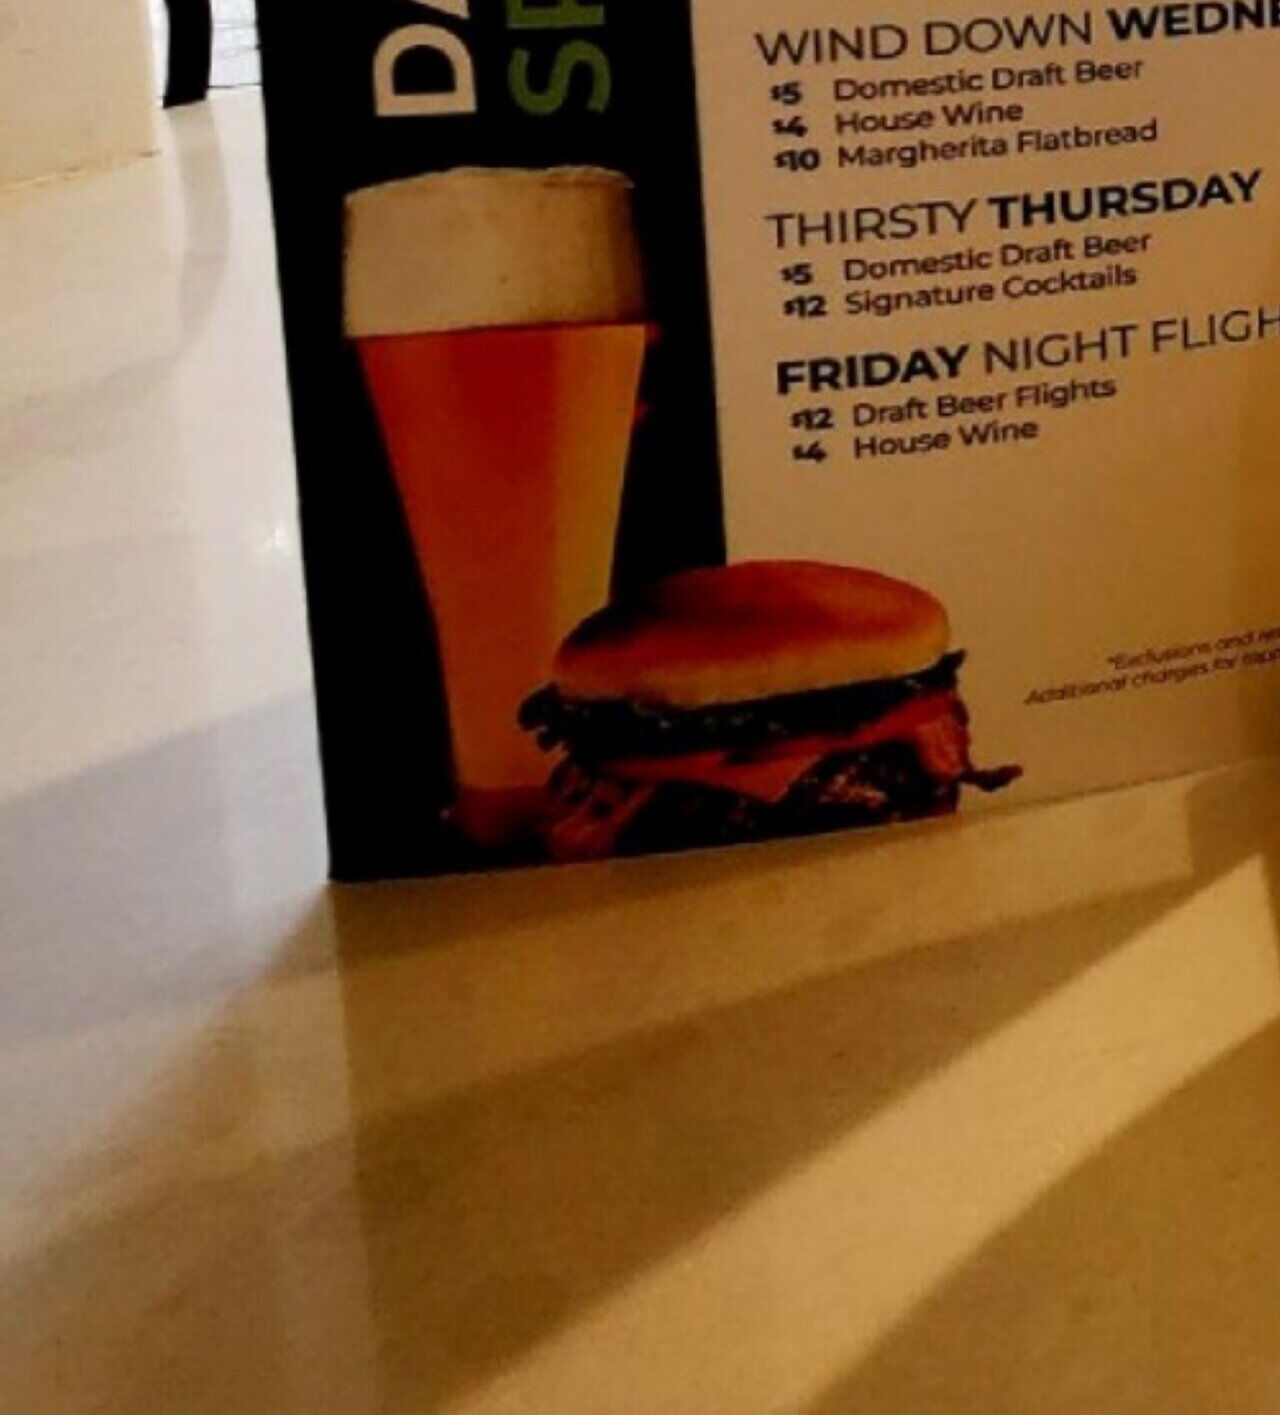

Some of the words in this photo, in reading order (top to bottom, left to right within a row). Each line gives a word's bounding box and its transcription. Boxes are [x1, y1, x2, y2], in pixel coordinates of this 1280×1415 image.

[753, 23, 909, 67] WIND
[923, 10, 1093, 56] DOWN
[769, 80, 804, 106] $5
[833, 68, 985, 102] Domestic
[991, 61, 1067, 92] Draft
[1074, 59, 1144, 85] Beer
[771, 115, 809, 138] $4
[834, 110, 937, 136] House
[940, 100, 1024, 128] Wine
[773, 147, 821, 172] $10
[837, 135, 1009, 169] Margherita
[1016, 117, 1158, 154] Flatbread
[763, 197, 978, 250] THIRSTY
[986, 168, 1262, 230] THURSDAY
[780, 262, 814, 286] $5
[843, 246, 993, 282] Domestic
[999, 238, 1075, 267] Draft
[1083, 233, 1152, 259] Beer
[783, 294, 829, 319] $12
[844, 283, 996, 317] Signature
[1001, 263, 1138, 300] Cocktails
[776, 343, 970, 396] FRIDAY
[983, 323, 1139, 375] NIGHT
[790, 406, 835, 432] $12
[852, 396, 929, 428] Draft
[936, 392, 1008, 419] Beer
[1014, 378, 1118, 409] Flights
[792, 440, 828, 464] $4
[853, 431, 952, 460] House
[957, 419, 1040, 447] Wine
